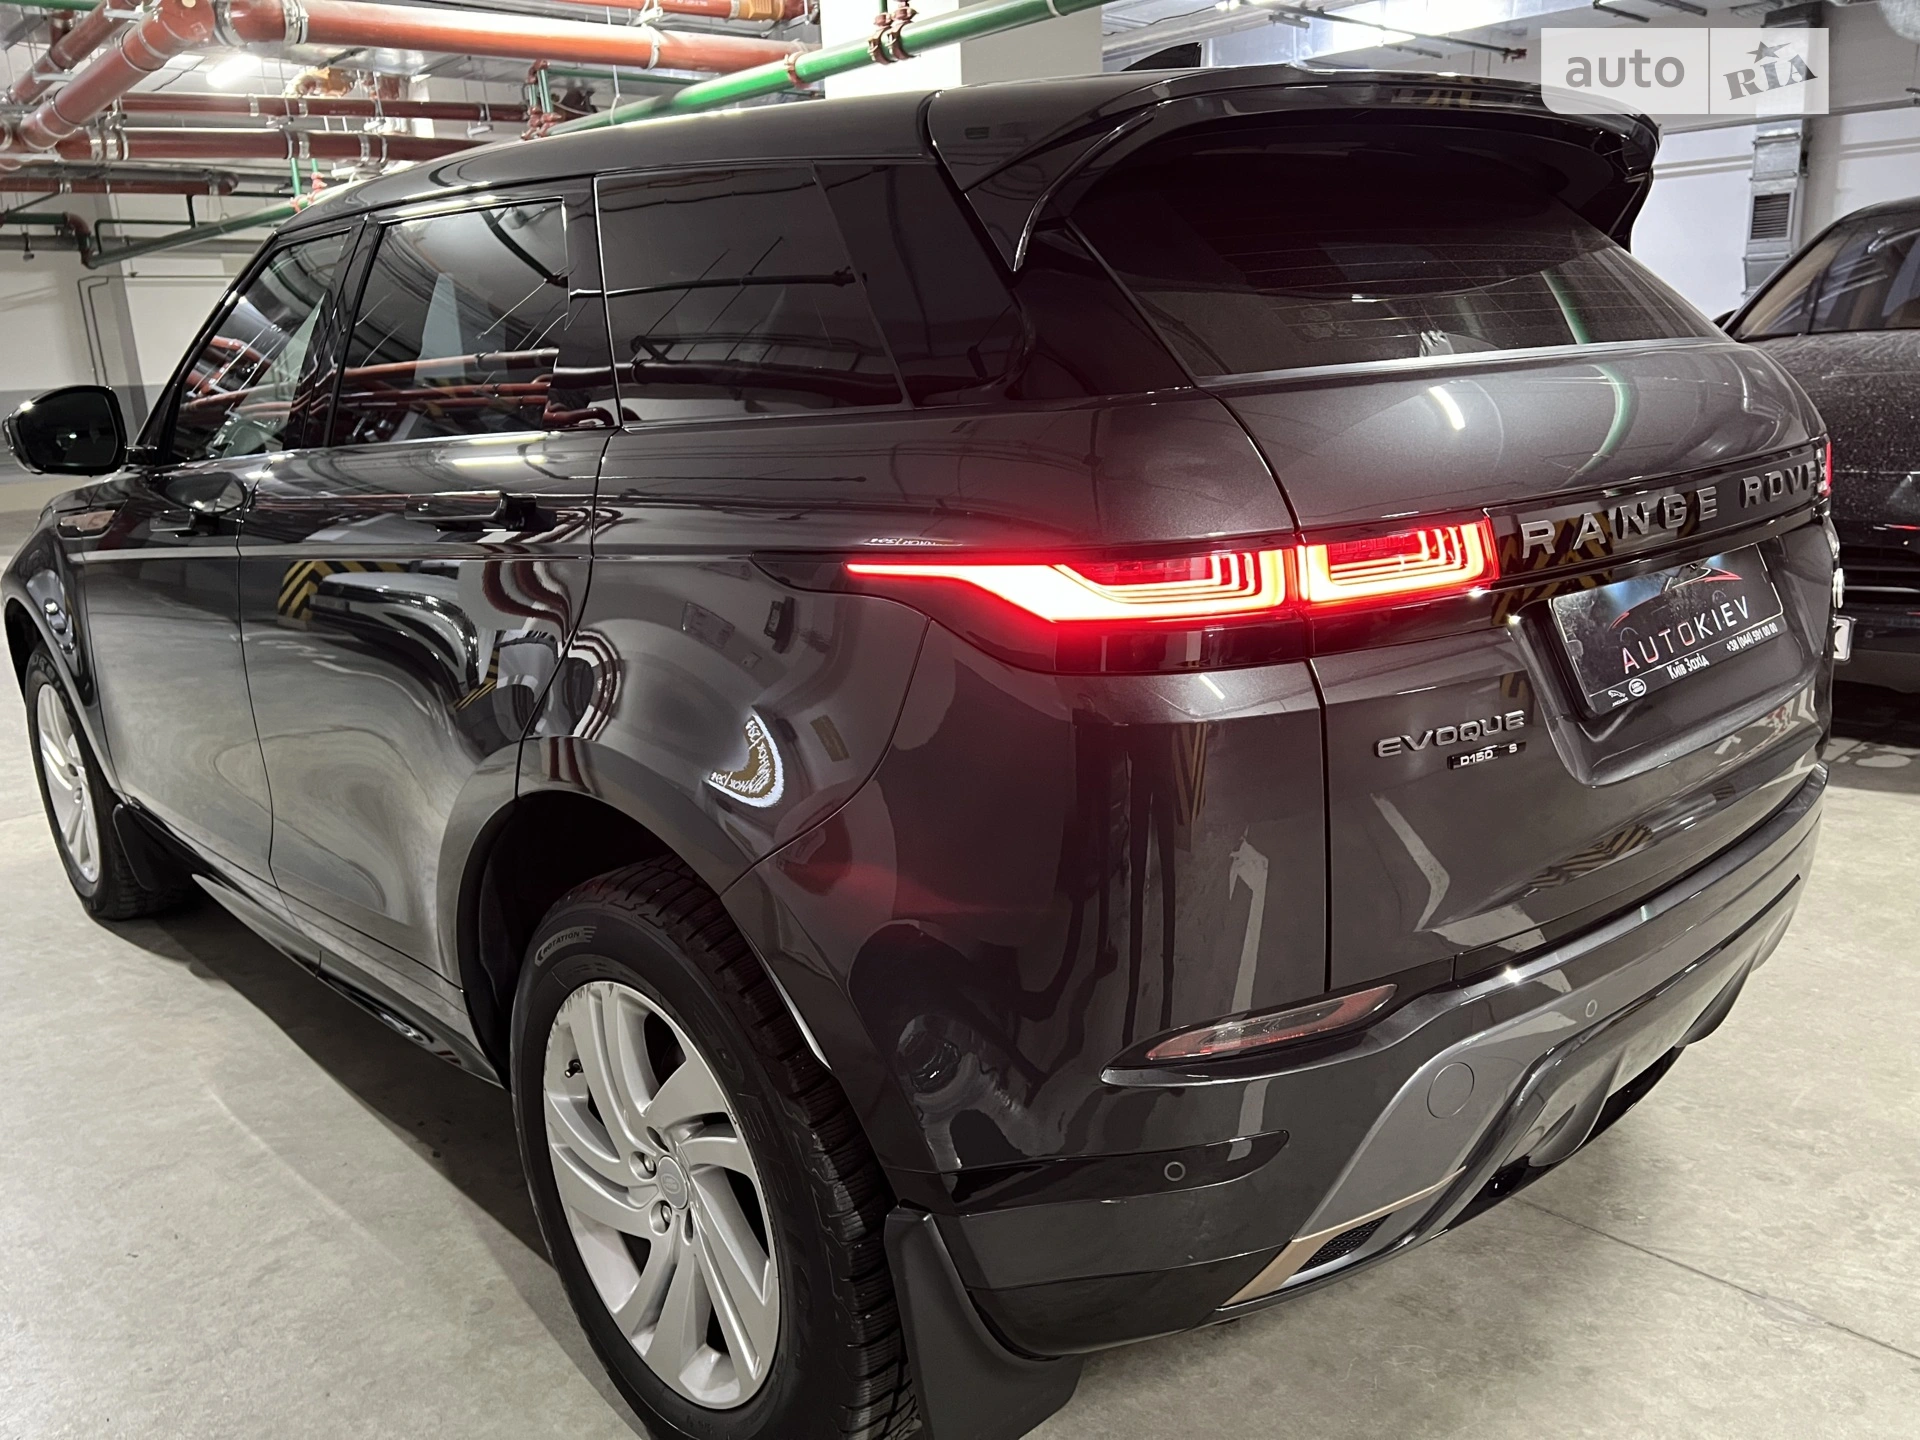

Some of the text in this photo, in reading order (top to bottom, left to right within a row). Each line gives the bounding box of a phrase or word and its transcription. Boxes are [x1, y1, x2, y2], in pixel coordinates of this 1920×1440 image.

[1520, 485, 1719, 560] RANGE
[1622, 595, 1749, 675] AUTOKIEV
[1666, 653, 1710, 680] Київ Захід
[1376, 710, 1525, 758] EVOQUE
[1460, 743, 1518, 767] D150 S
[542, 931, 581, 955] ROTATION
